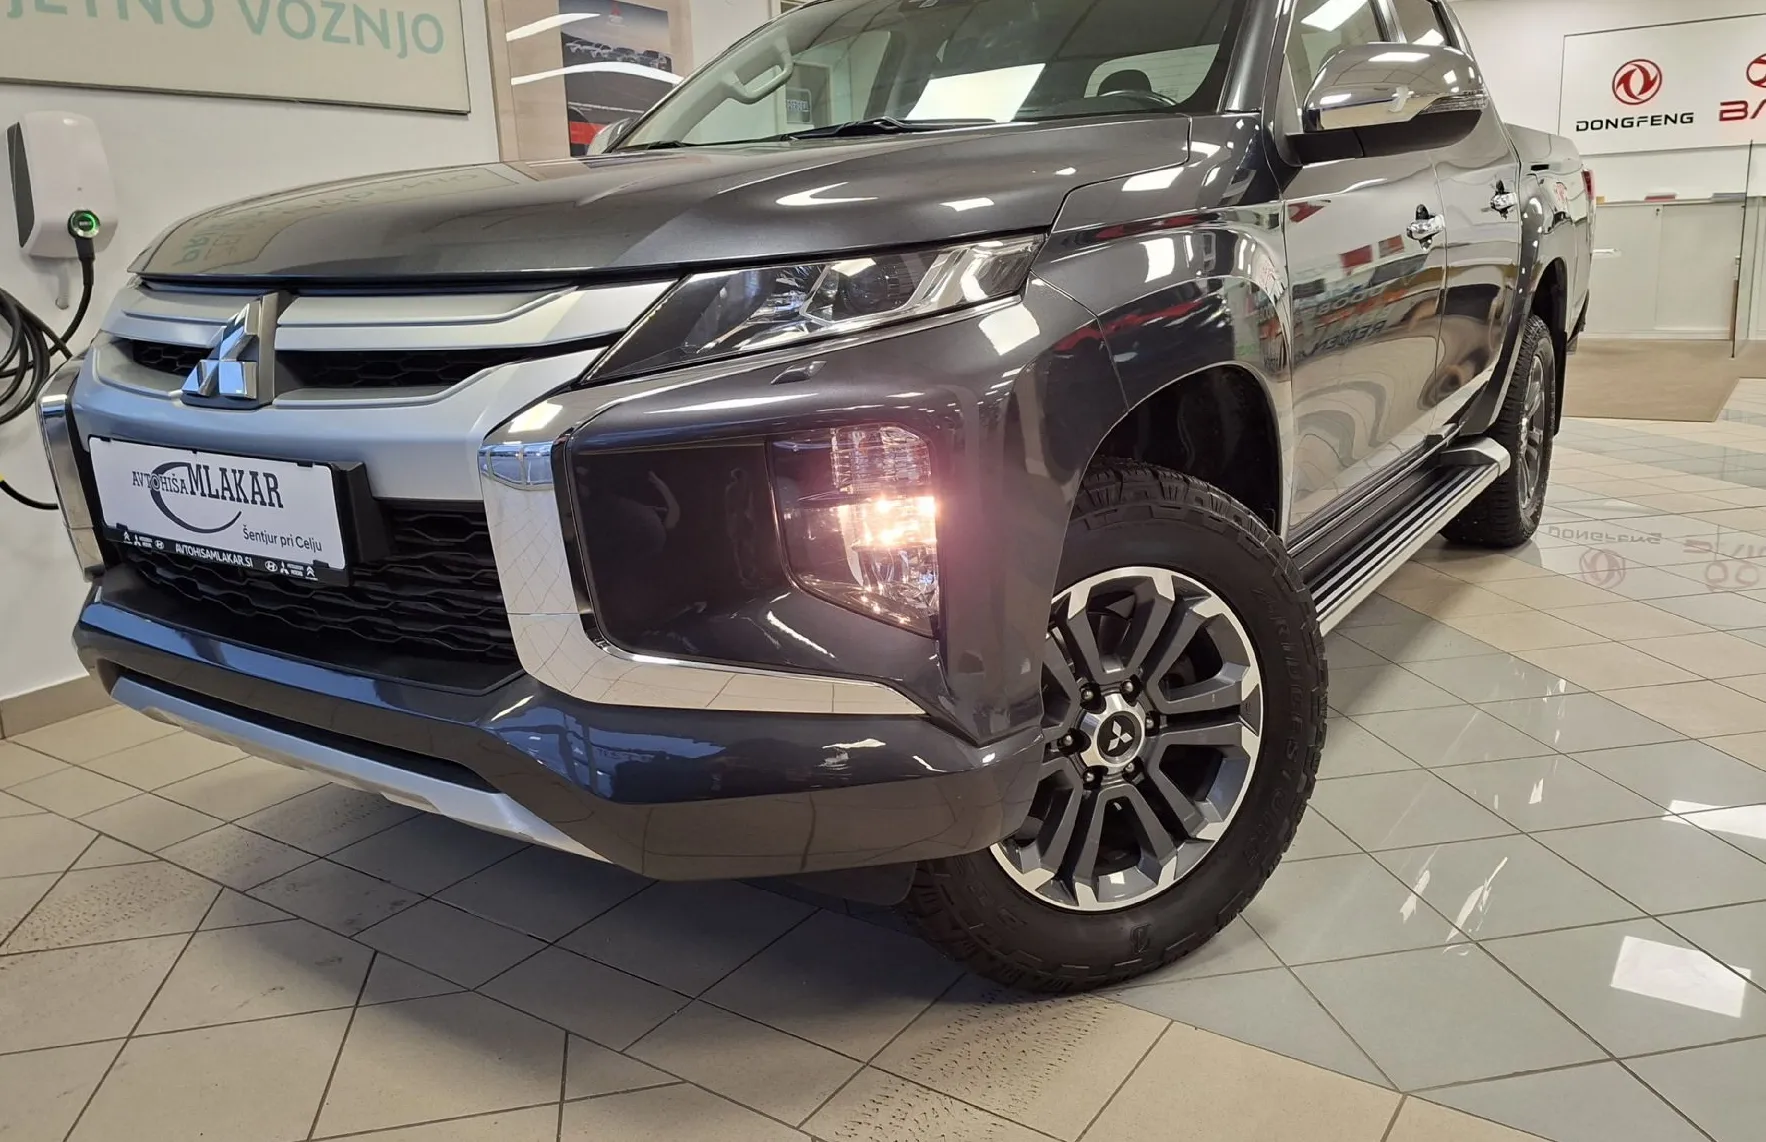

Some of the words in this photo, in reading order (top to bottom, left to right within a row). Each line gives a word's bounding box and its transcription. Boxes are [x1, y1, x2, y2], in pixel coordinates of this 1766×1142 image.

[240, 0, 444, 59] VOZNJO
[1576, 112, 1694, 131] DONGFENG
[187, 464, 284, 508] MLAKAR
[243, 525, 278, 546] Šentjur
[280, 532, 294, 548] pri
[295, 536, 322, 552] Celju
[175, 543, 253, 567] AVTOHISAMLAKAR.SI
